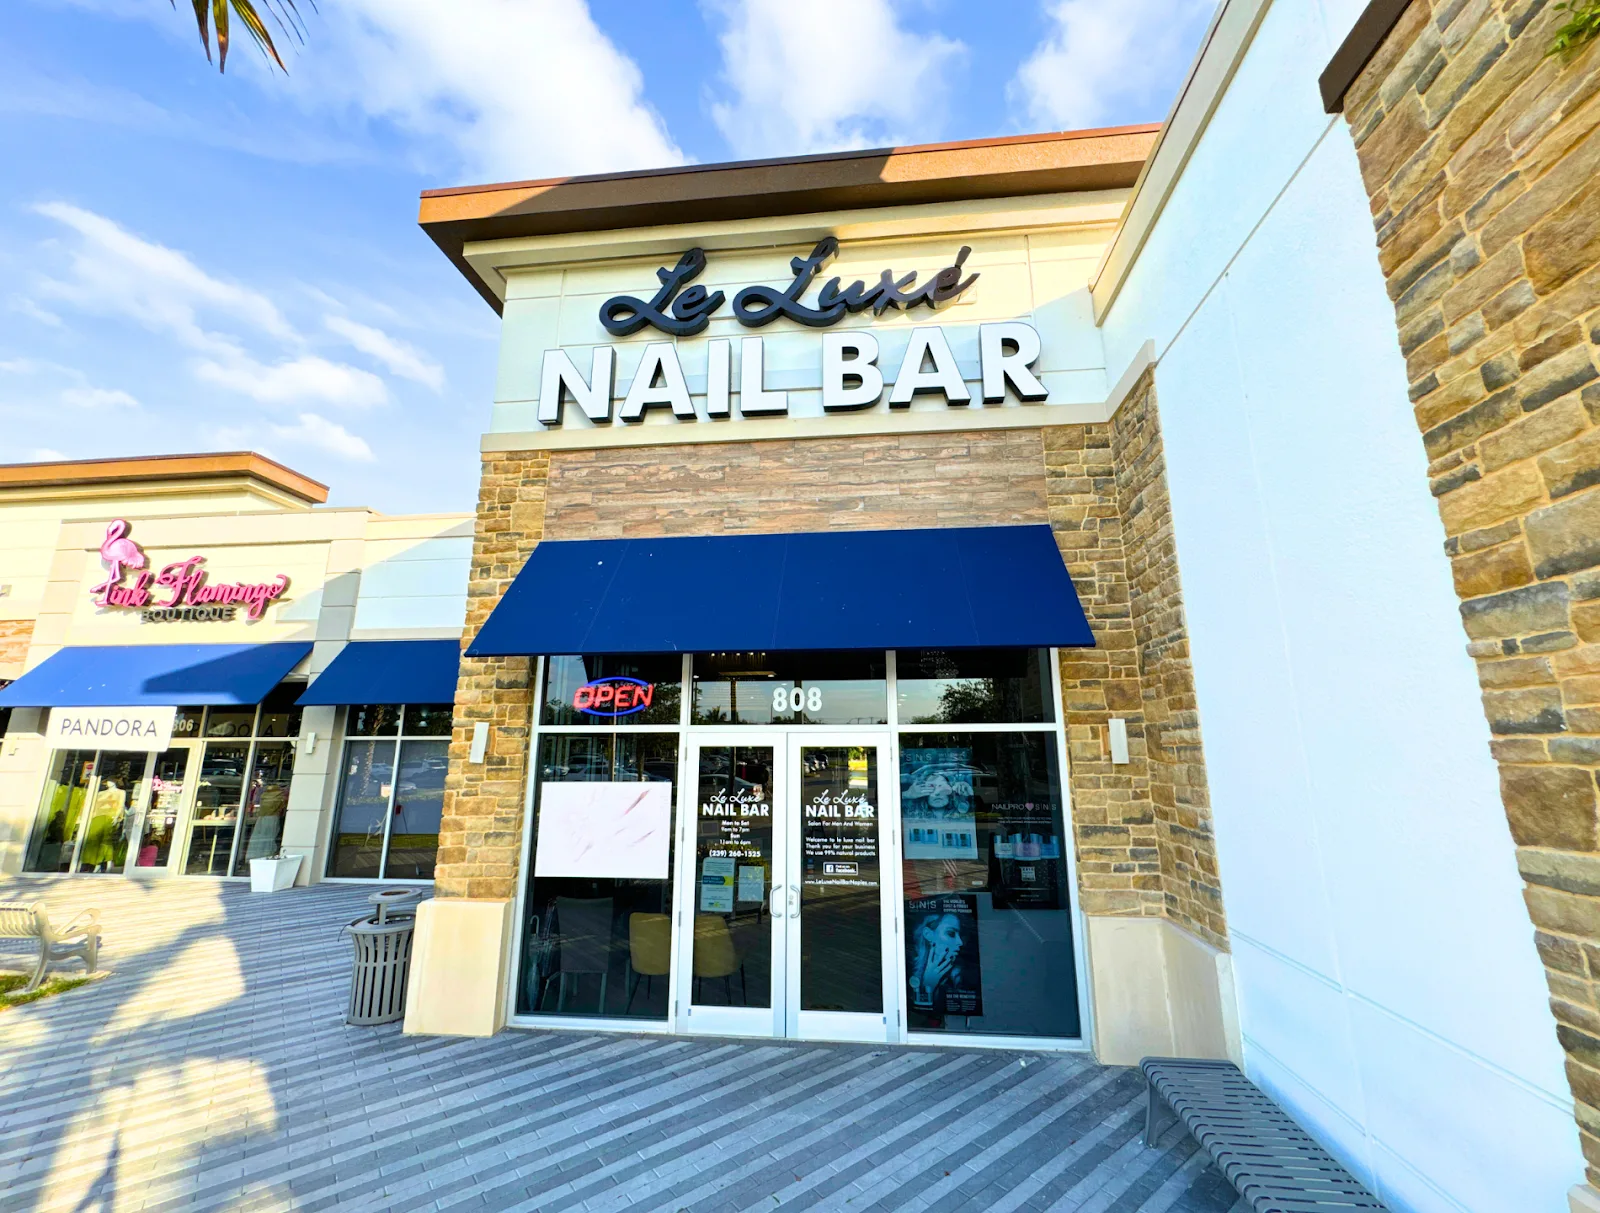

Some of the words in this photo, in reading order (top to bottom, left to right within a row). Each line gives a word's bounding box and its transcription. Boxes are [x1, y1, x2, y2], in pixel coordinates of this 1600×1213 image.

[600, 247, 725, 336] Le
[733, 236, 980, 327] Luxé
[537, 336, 788, 425] NAIL
[822, 322, 1049, 413] BAR
[155, 555, 287, 619] Flamingo
[141, 606, 235, 622] BOUTIQUE
[573, 684, 654, 709] OPEN
[772, 686, 823, 712] 808
[60, 718, 158, 737] PANDORA
[710, 787, 728, 804] Le
[813, 788, 831, 805] Le
[702, 803, 737, 816] NAIL
[740, 803, 769, 817] BAR
[805, 804, 841, 818] NAIL
[844, 804, 875, 818] BAR
[992, 803, 1024, 811] NAILPRO
[709, 849, 727, 858] (239)
[728, 850, 761, 858] 260-1525
